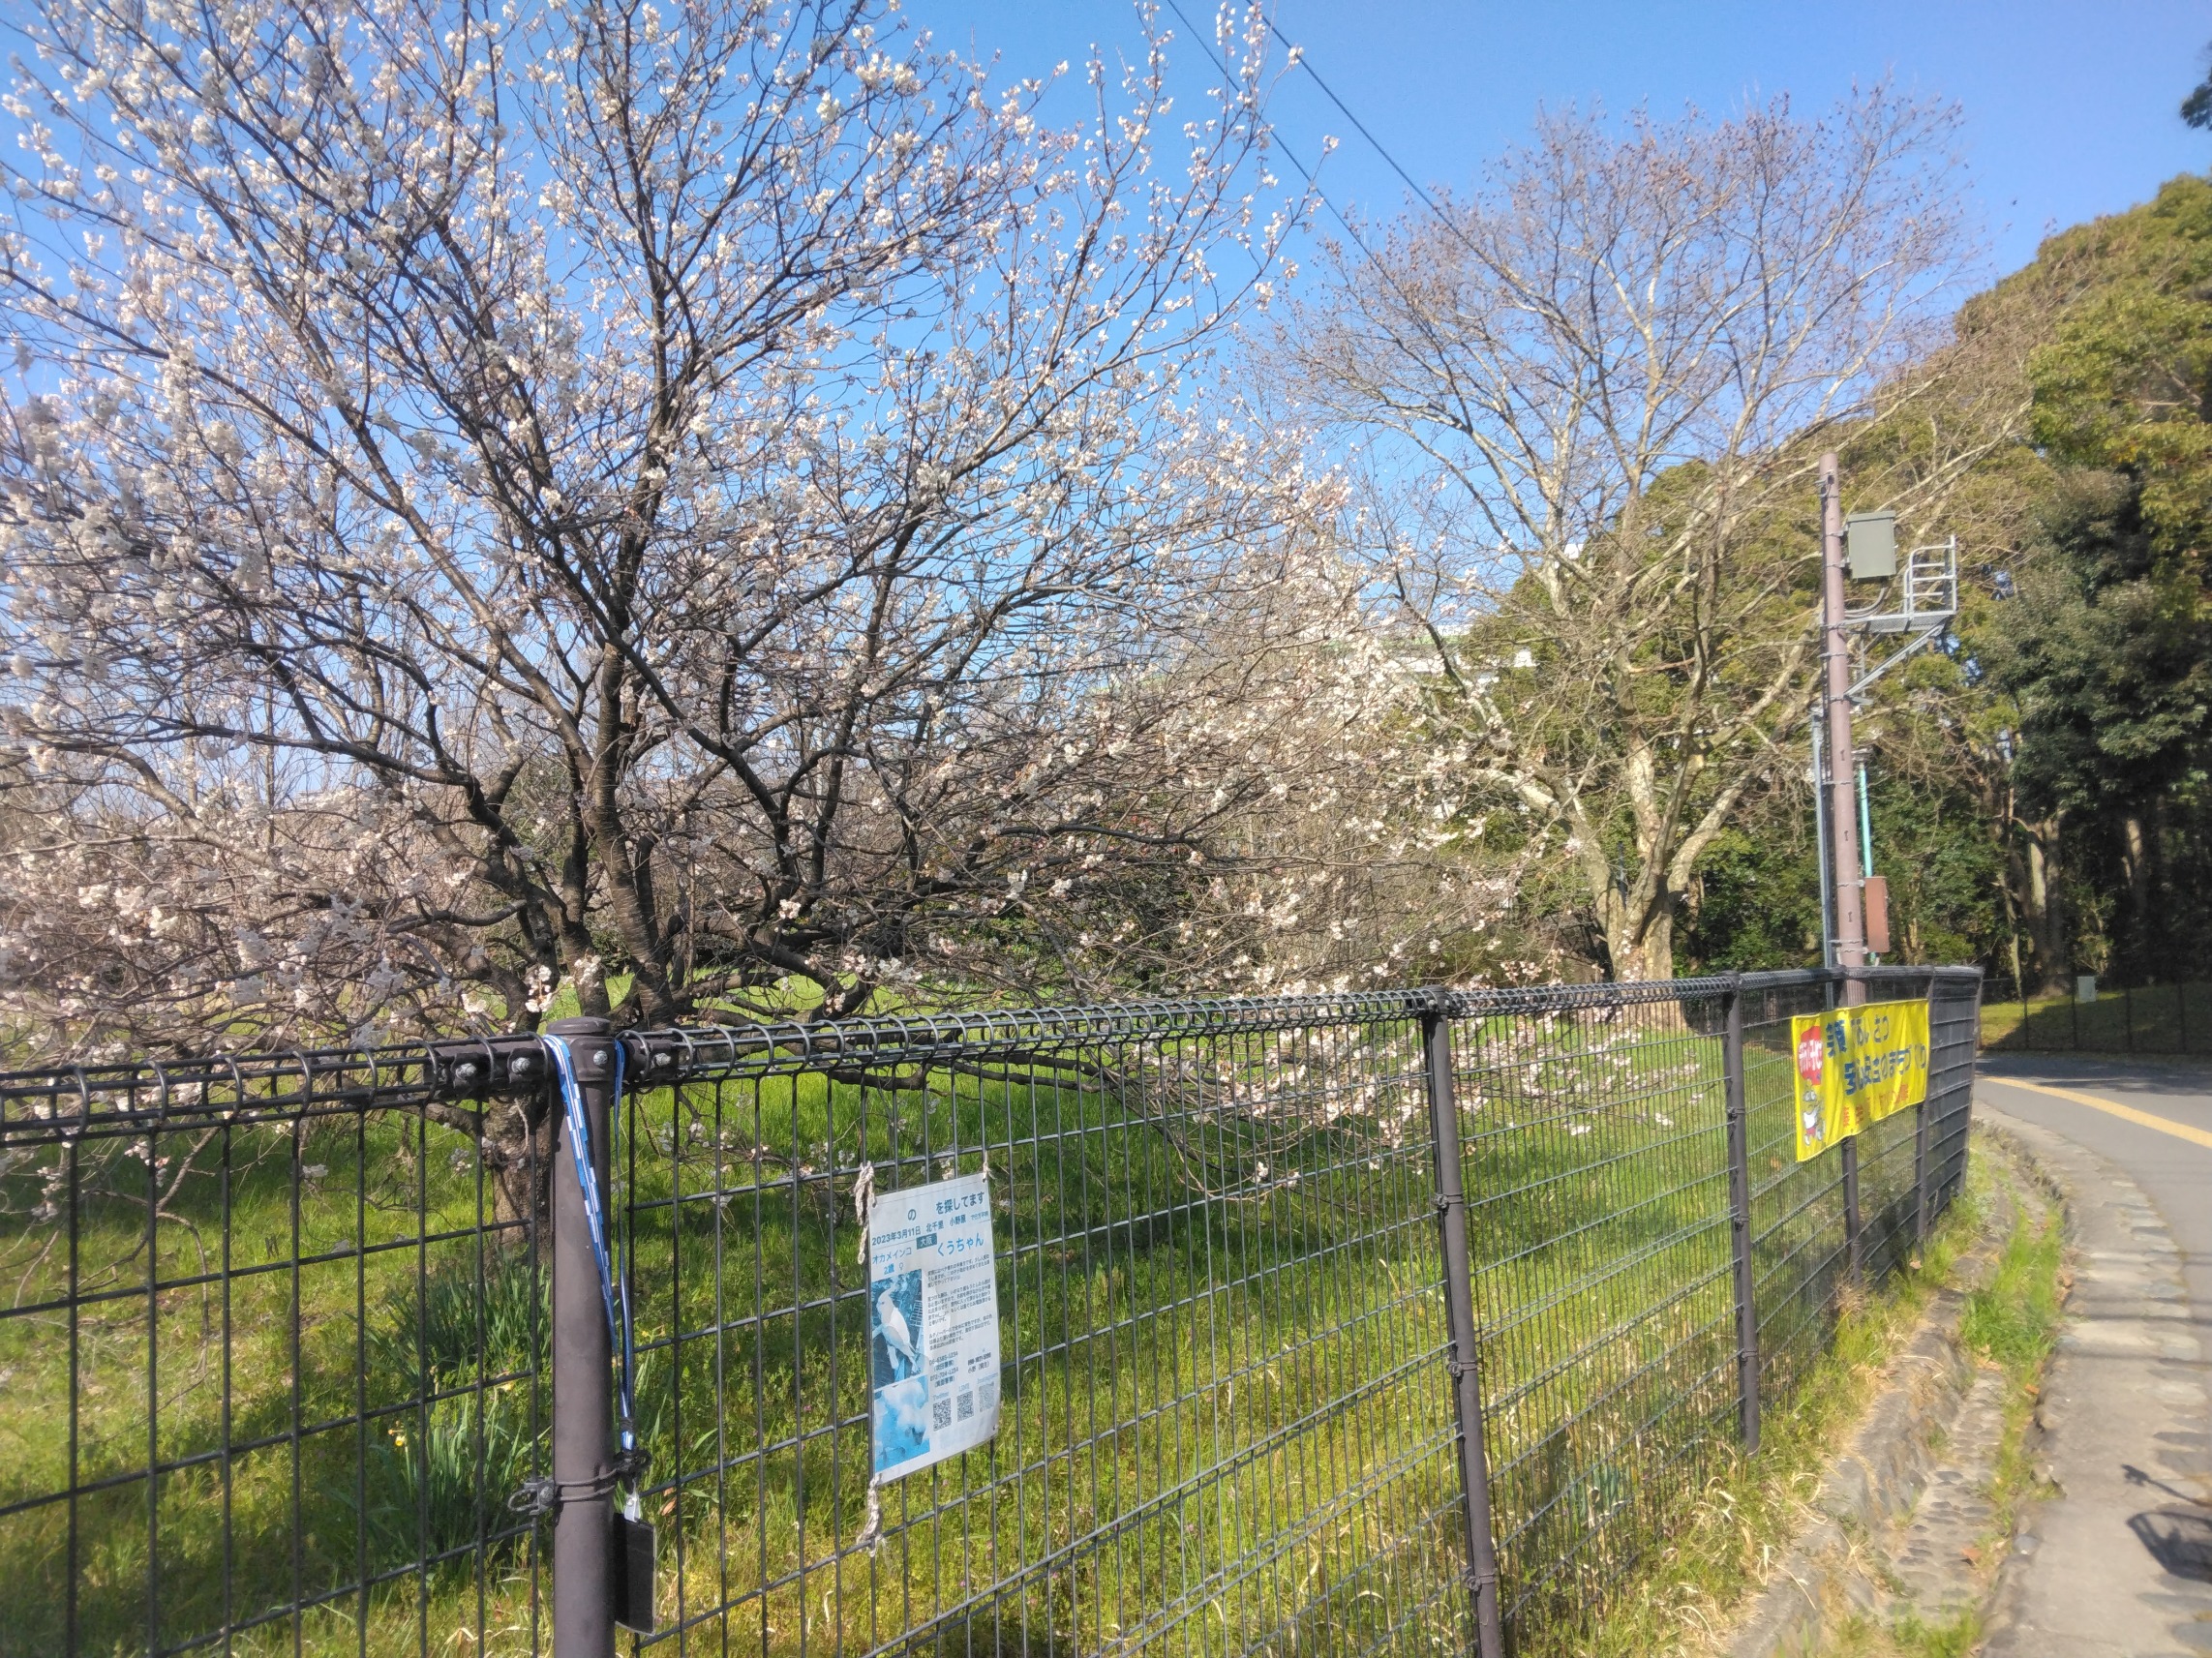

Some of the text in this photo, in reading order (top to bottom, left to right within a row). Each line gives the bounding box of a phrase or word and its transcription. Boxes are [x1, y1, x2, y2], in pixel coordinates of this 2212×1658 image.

[907, 1191, 985, 1221] の を探してます
[872, 1225, 922, 1246] 2023年3月11日
[925, 1220, 944, 1233] 北千里
[950, 1214, 966, 1226] 小野原
[920, 1236, 933, 1247] 大阪
[872, 1247, 912, 1264] オカメインコ
[937, 1232, 985, 1256] くうちゃん
